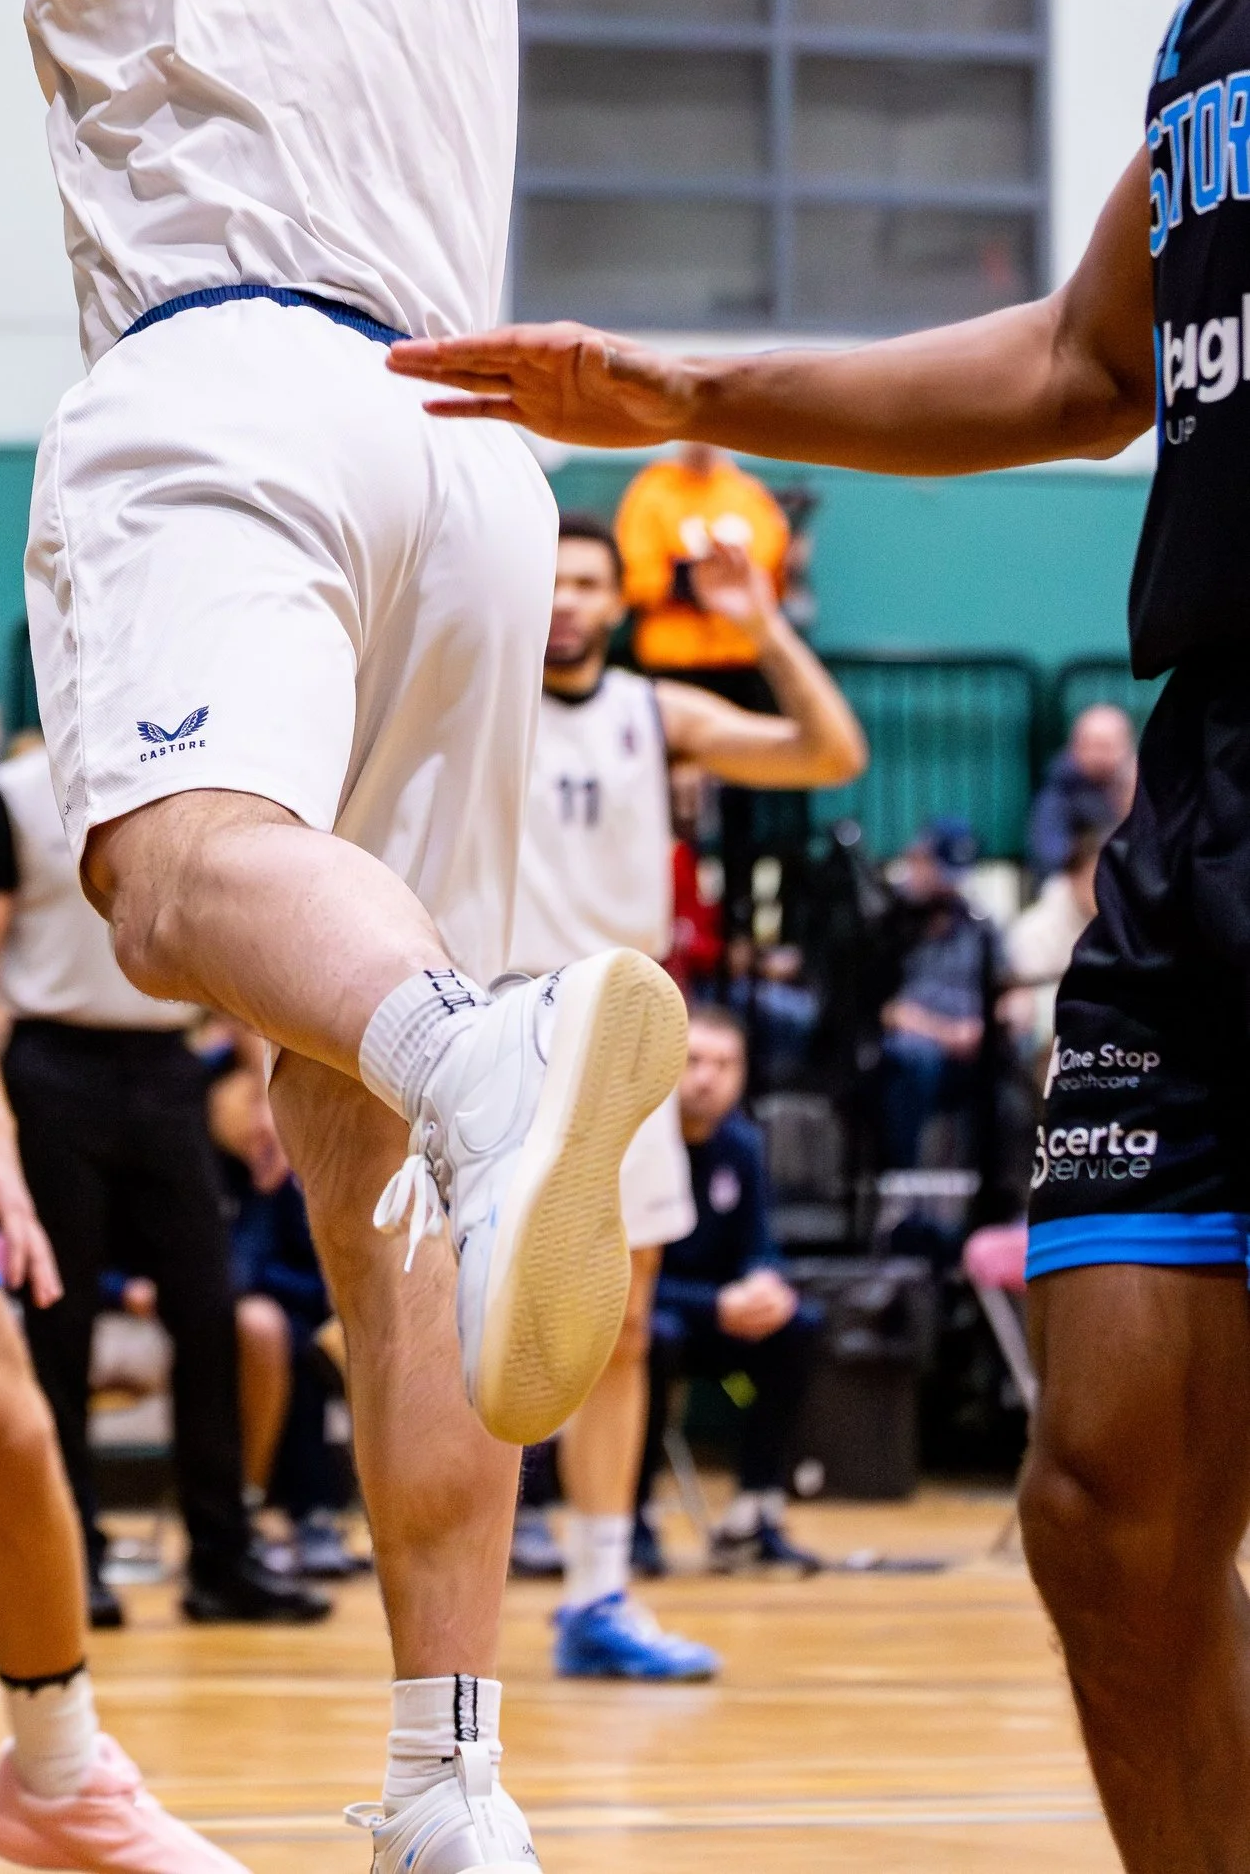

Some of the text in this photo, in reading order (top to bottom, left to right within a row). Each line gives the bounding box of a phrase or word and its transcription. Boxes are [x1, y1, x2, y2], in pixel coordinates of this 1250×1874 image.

[140, 739, 207, 763] CASTORE
[1059, 1042, 1161, 1073] One Stop
[1048, 1121, 1158, 1158] certa
